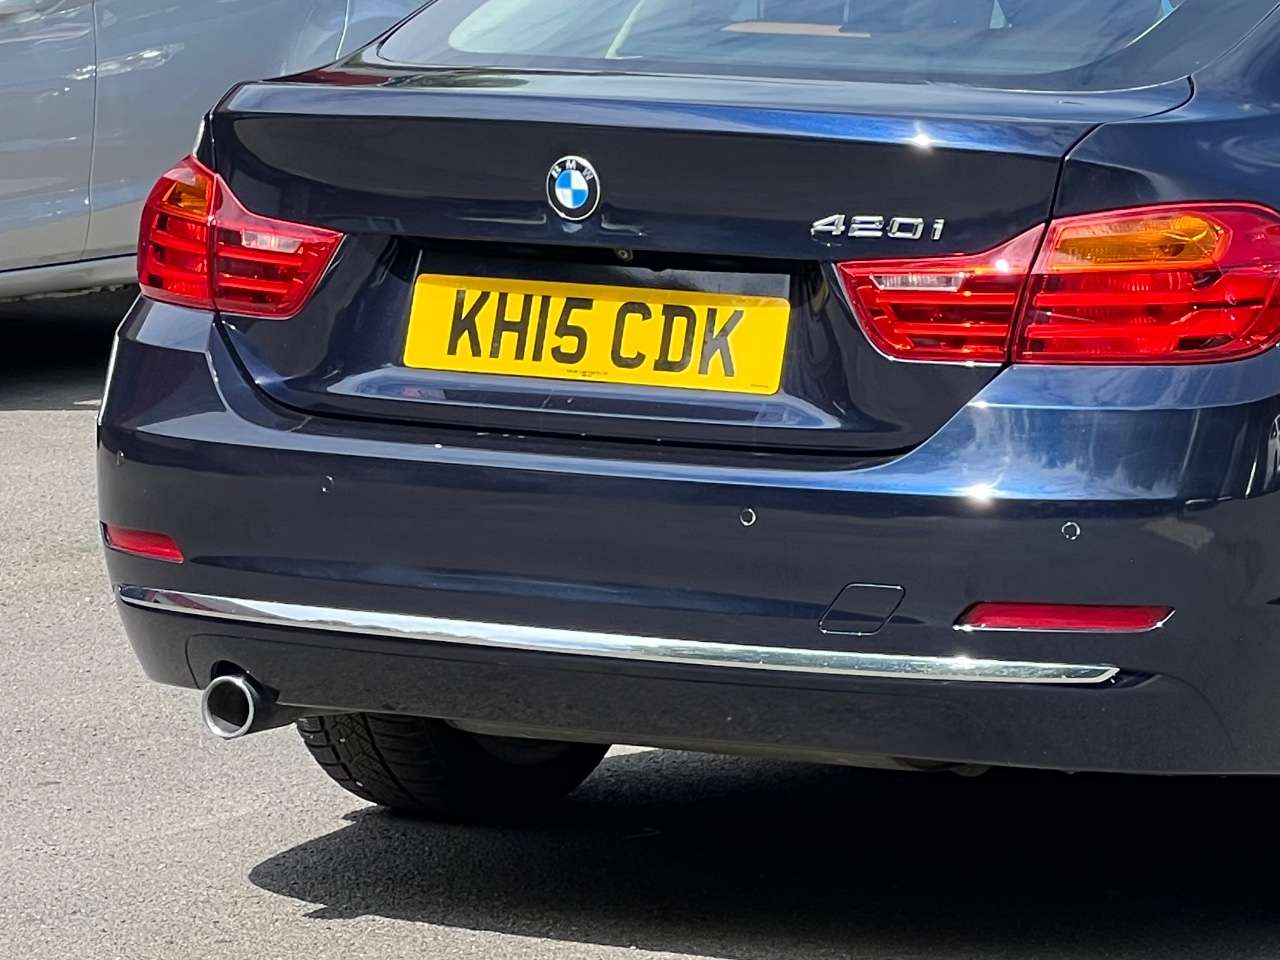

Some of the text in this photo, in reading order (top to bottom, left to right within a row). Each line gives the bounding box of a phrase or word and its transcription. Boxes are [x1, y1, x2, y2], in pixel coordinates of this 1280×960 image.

[551, 159, 593, 181] BMW
[810, 214, 945, 240] 420i
[447, 289, 745, 377] KH15 CDK
